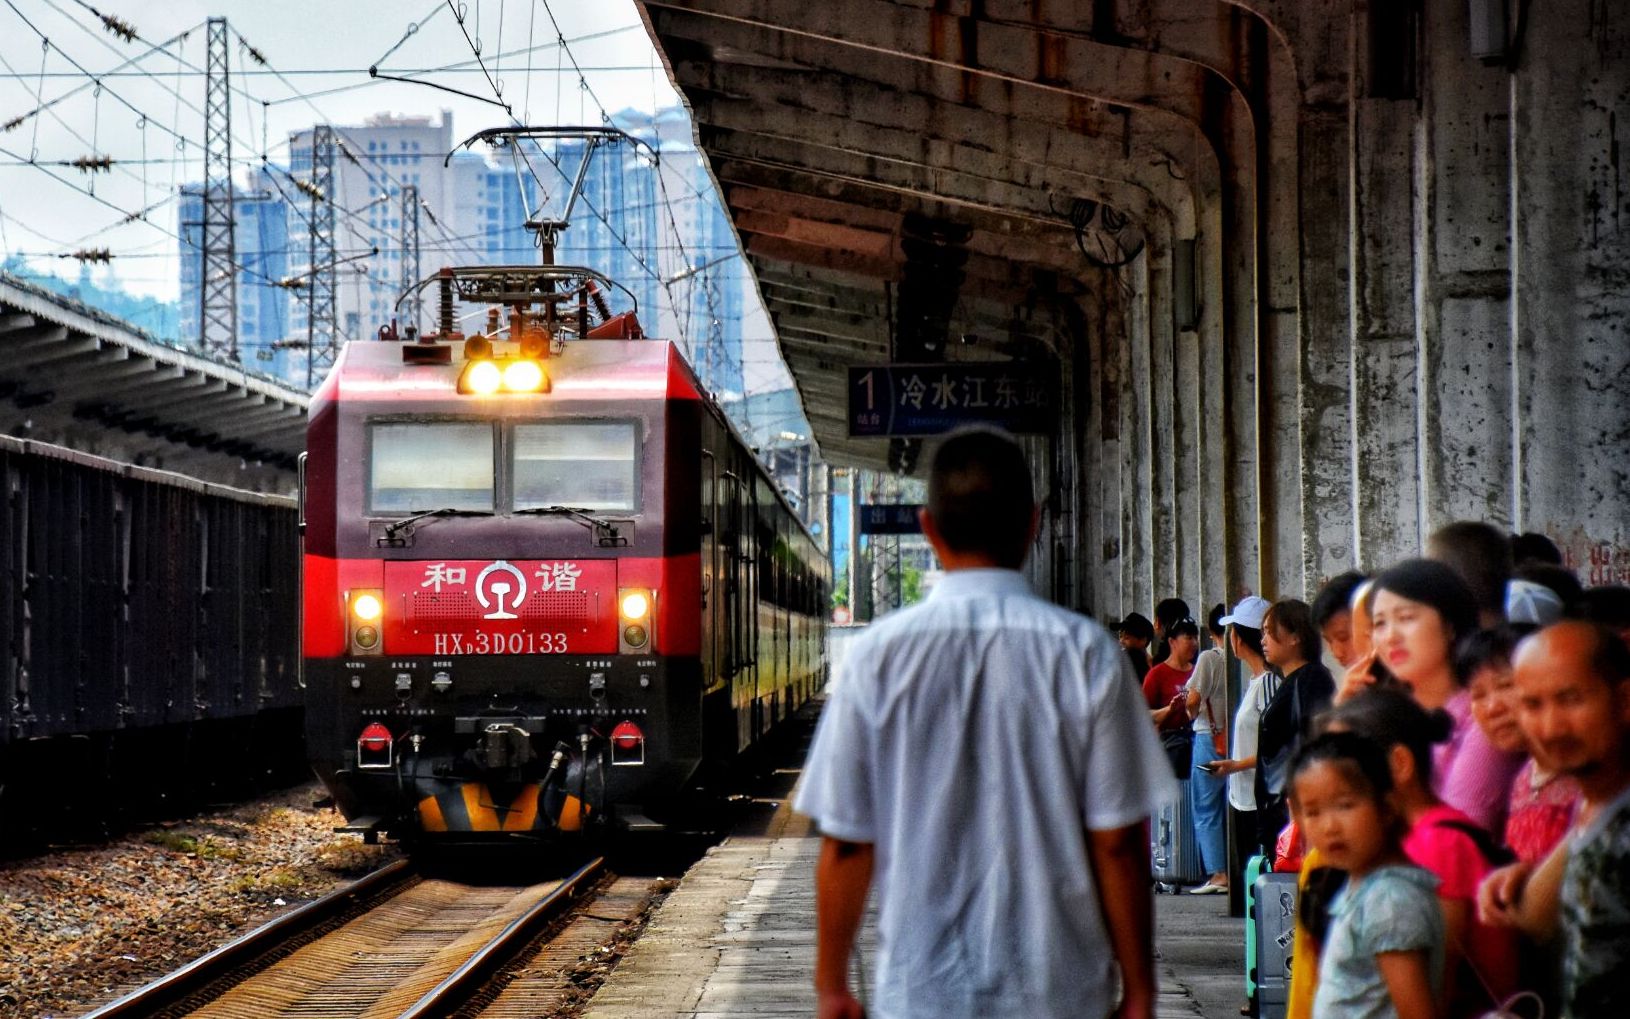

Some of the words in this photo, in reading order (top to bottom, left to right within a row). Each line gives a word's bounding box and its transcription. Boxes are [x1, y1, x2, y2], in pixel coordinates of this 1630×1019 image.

[858, 370, 874, 410] 1
[901, 373, 1048, 411] 冷水江东站
[434, 633, 568, 655] HXD3D0133
